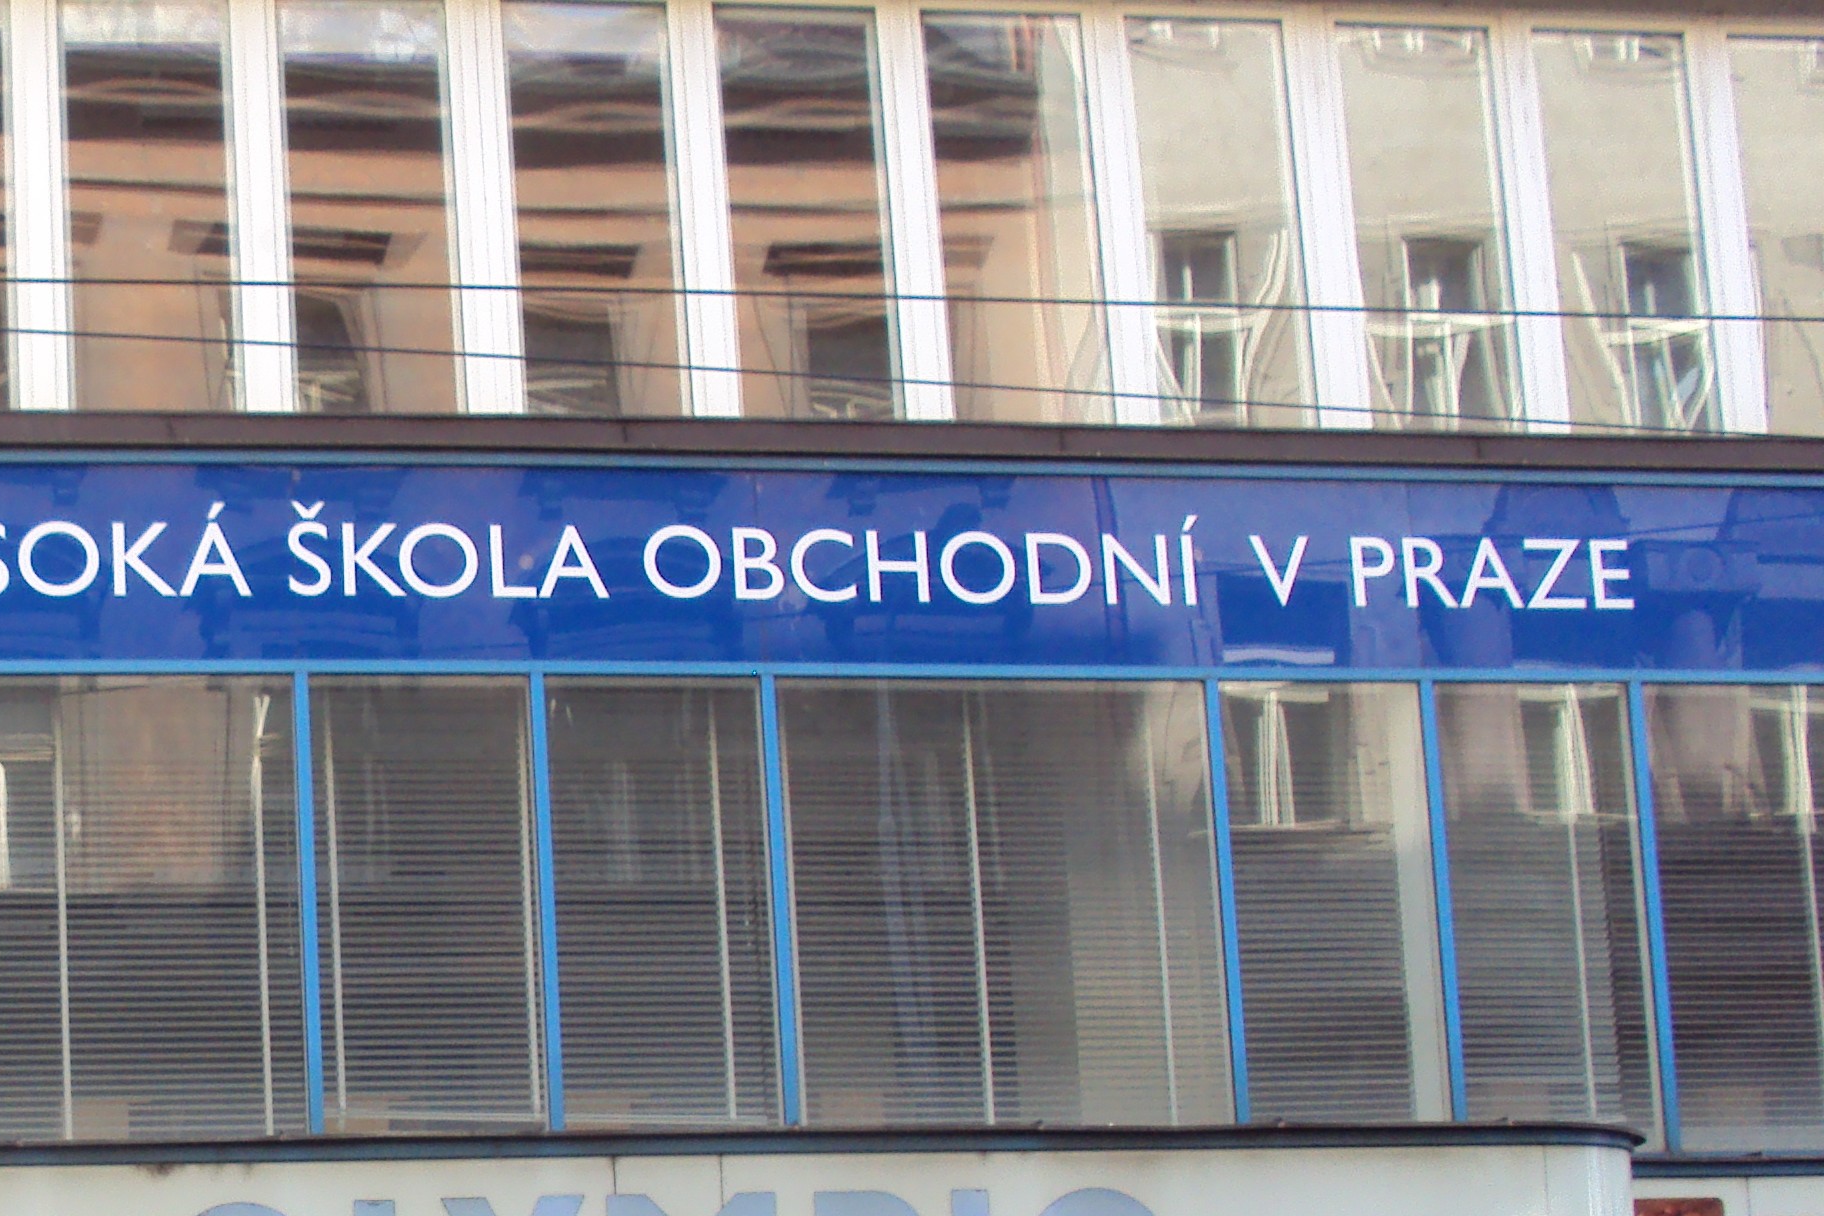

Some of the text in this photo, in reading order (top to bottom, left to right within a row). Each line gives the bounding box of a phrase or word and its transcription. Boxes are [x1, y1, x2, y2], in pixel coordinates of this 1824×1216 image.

[286, 500, 610, 599] ŠKOLA
[642, 514, 1199, 606] OBCHODNÍ
[1249, 534, 1310, 608] V
[1349, 535, 1637, 611] PRAZE
